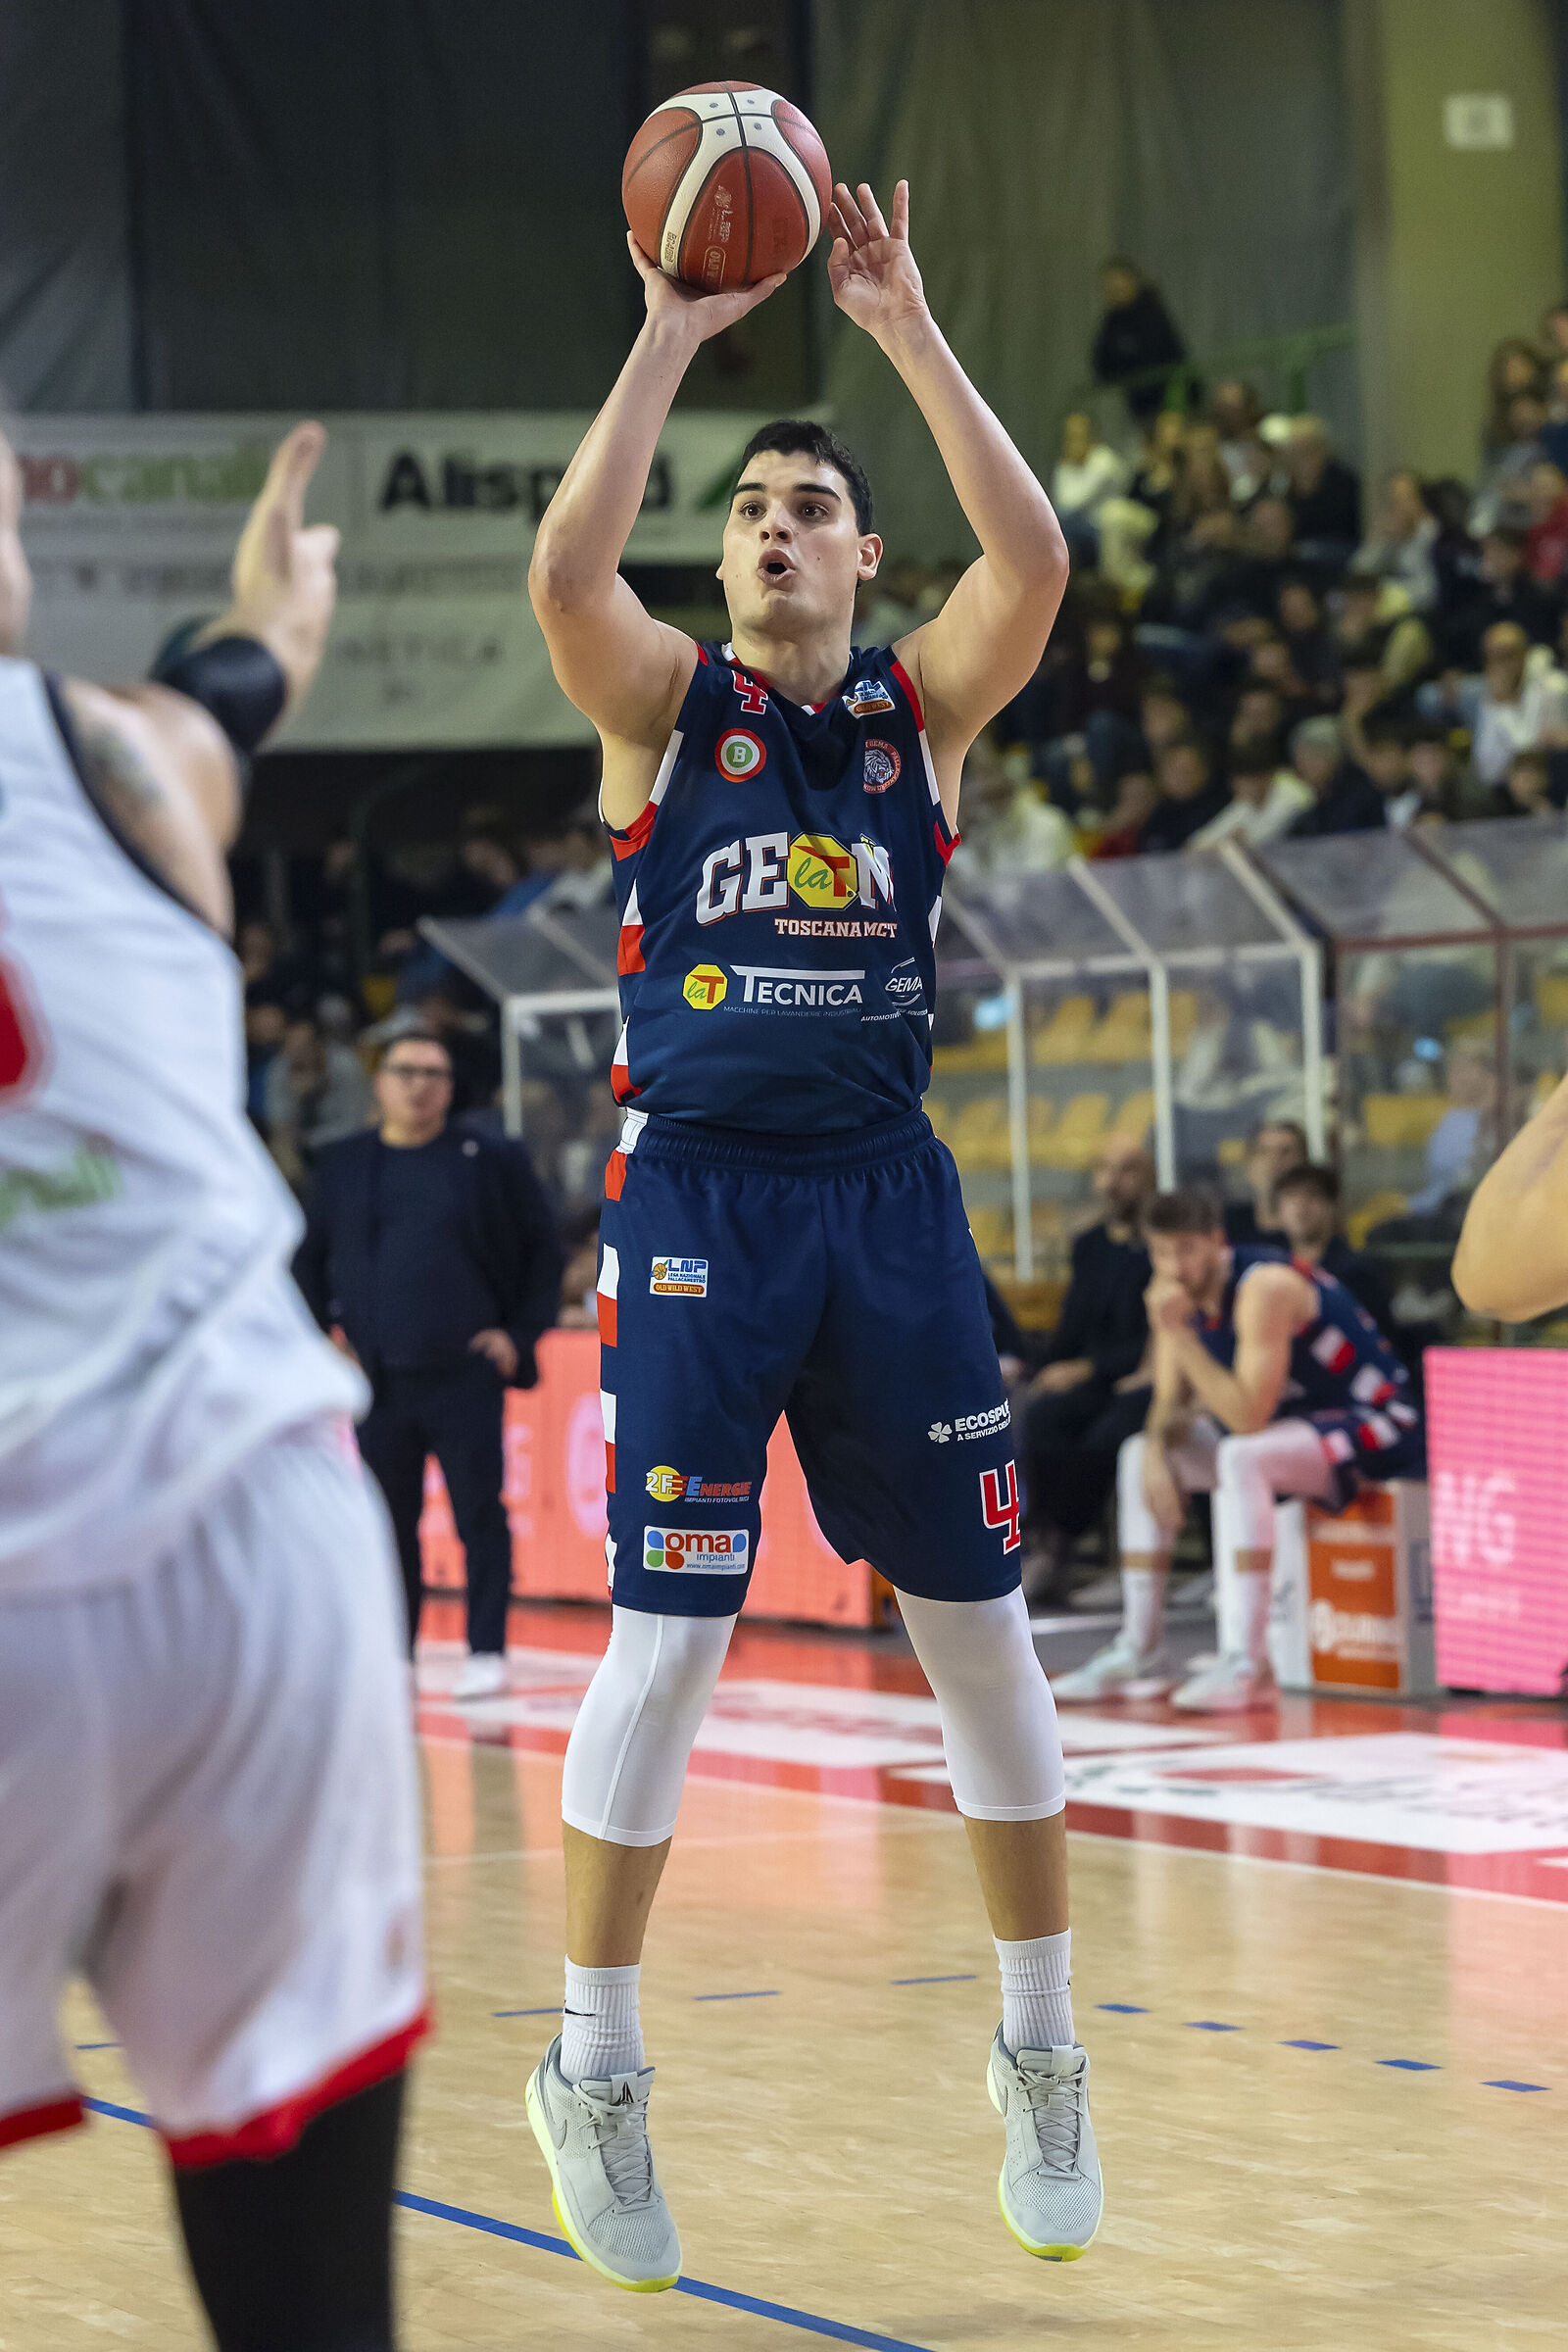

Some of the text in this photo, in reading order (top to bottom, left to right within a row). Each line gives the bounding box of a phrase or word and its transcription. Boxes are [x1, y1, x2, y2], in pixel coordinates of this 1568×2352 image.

[731, 669, 768, 714] 4
[732, 746, 747, 763] B
[774, 917, 898, 939] TOSCANA MCT
[729, 964, 865, 1006] TECNICA
[884, 976, 923, 993] GEMA
[723, 1005, 760, 1015] MACCHINE
[668, 1258, 707, 1273] LNP
[683, 1285, 703, 1294] WEST
[957, 1433, 964, 1442] A
[964, 1425, 999, 1441] SERVIZIO
[979, 1458, 1021, 1555] 4
[664, 1532, 732, 1554] oma
[696, 1552, 736, 1564] impianti
